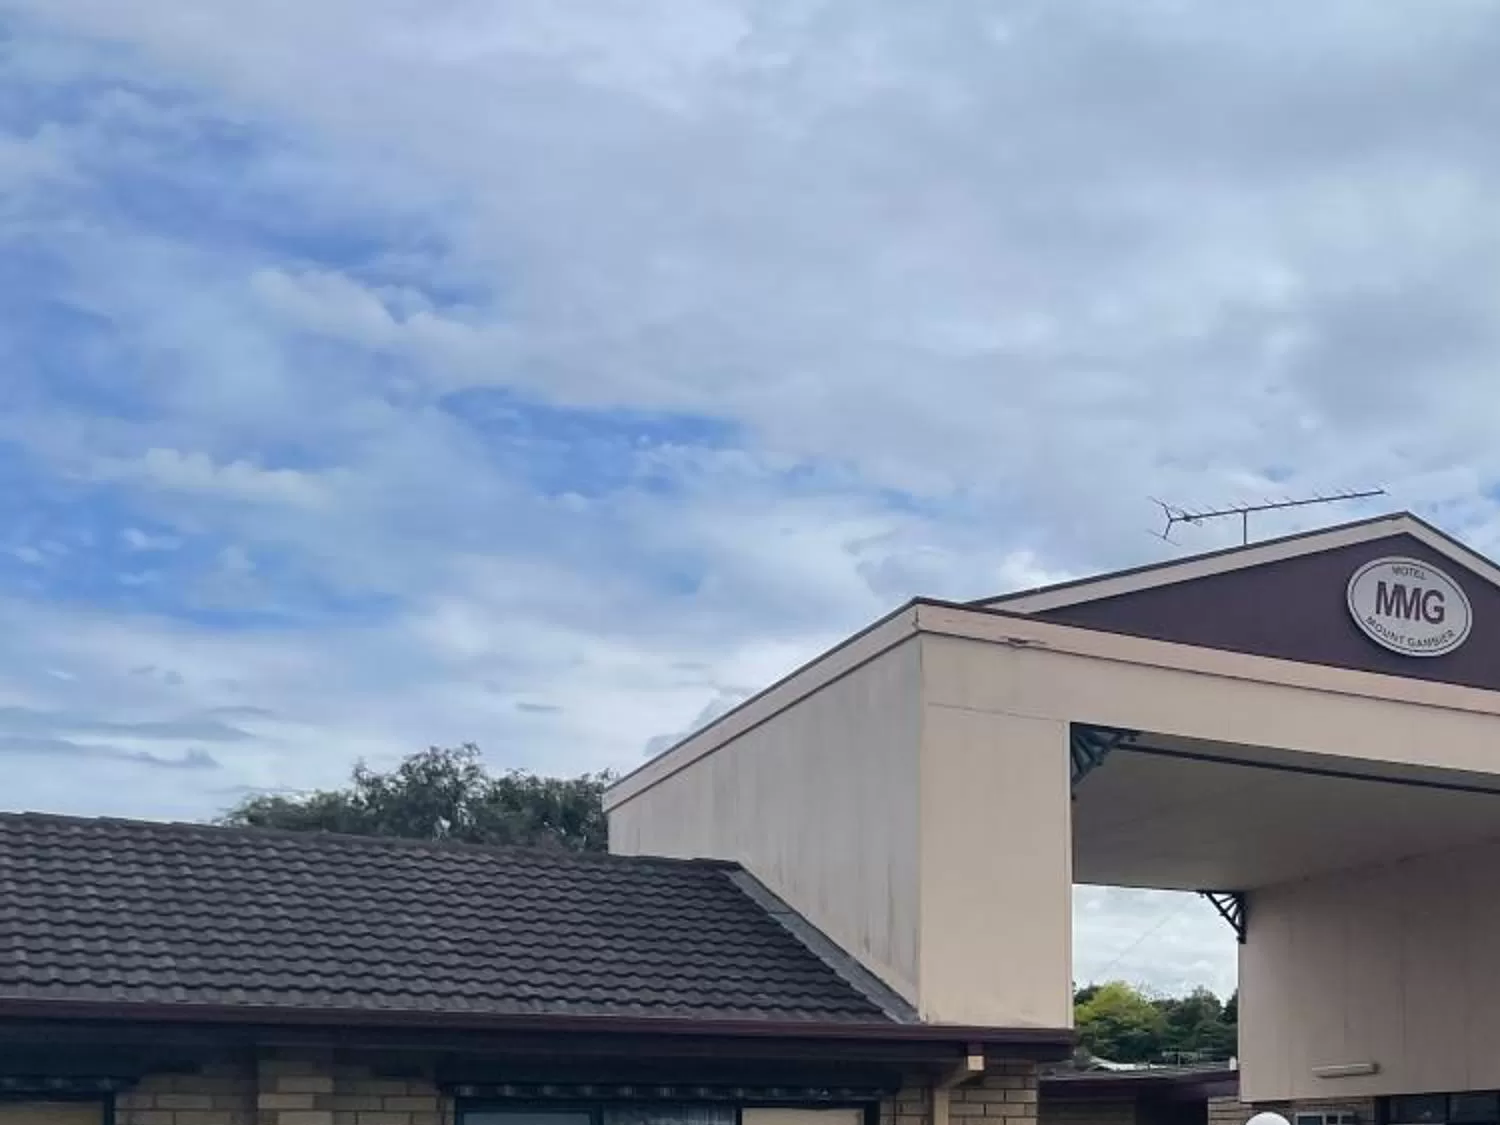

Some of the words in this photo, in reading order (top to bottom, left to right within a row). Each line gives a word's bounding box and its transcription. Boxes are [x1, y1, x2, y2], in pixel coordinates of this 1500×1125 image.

[1392, 565, 1427, 580] MOTEL
[1375, 580, 1445, 624] MMG
[1365, 616, 1405, 645] MOUNT
[1407, 629, 1456, 647] GAMBIER
